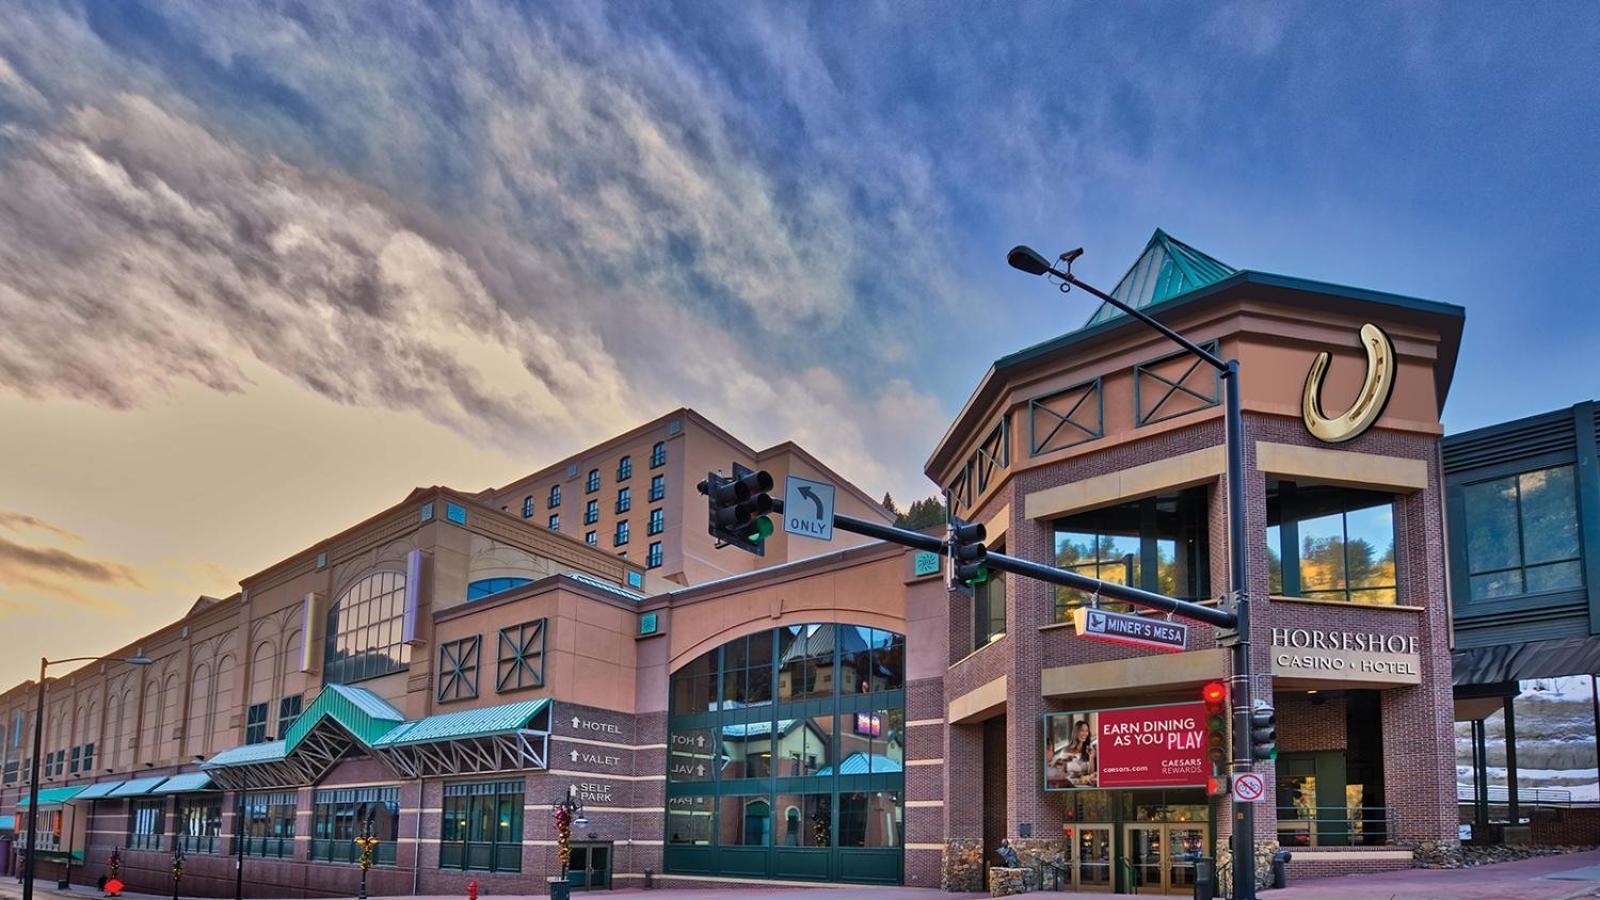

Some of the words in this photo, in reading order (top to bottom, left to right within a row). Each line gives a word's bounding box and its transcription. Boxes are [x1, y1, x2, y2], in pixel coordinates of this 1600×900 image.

[790, 518, 826, 534] ONLY
[1107, 618, 1151, 636] MINER'S
[1153, 626, 1182, 642] MESA
[1272, 628, 1420, 655] HORSESHOE
[1276, 654, 1344, 670] CASINO
[1361, 660, 1416, 675] HOTEL
[582, 720, 622, 735] HOTEL
[1104, 722, 1140, 735] EARN
[1144, 718, 1196, 732] DINING
[1114, 735, 1134, 747] AS
[1134, 732, 1164, 746] YOU
[1168, 730, 1204, 750] PLAY
[580, 753, 620, 766] VALET
[1161, 758, 1202, 767] CAESARS
[1103, 765, 1148, 774] caesars.com
[1162, 766, 1202, 774] REWARDS
[580, 783, 612, 793] SELF
[580, 793, 612, 802] PARK
